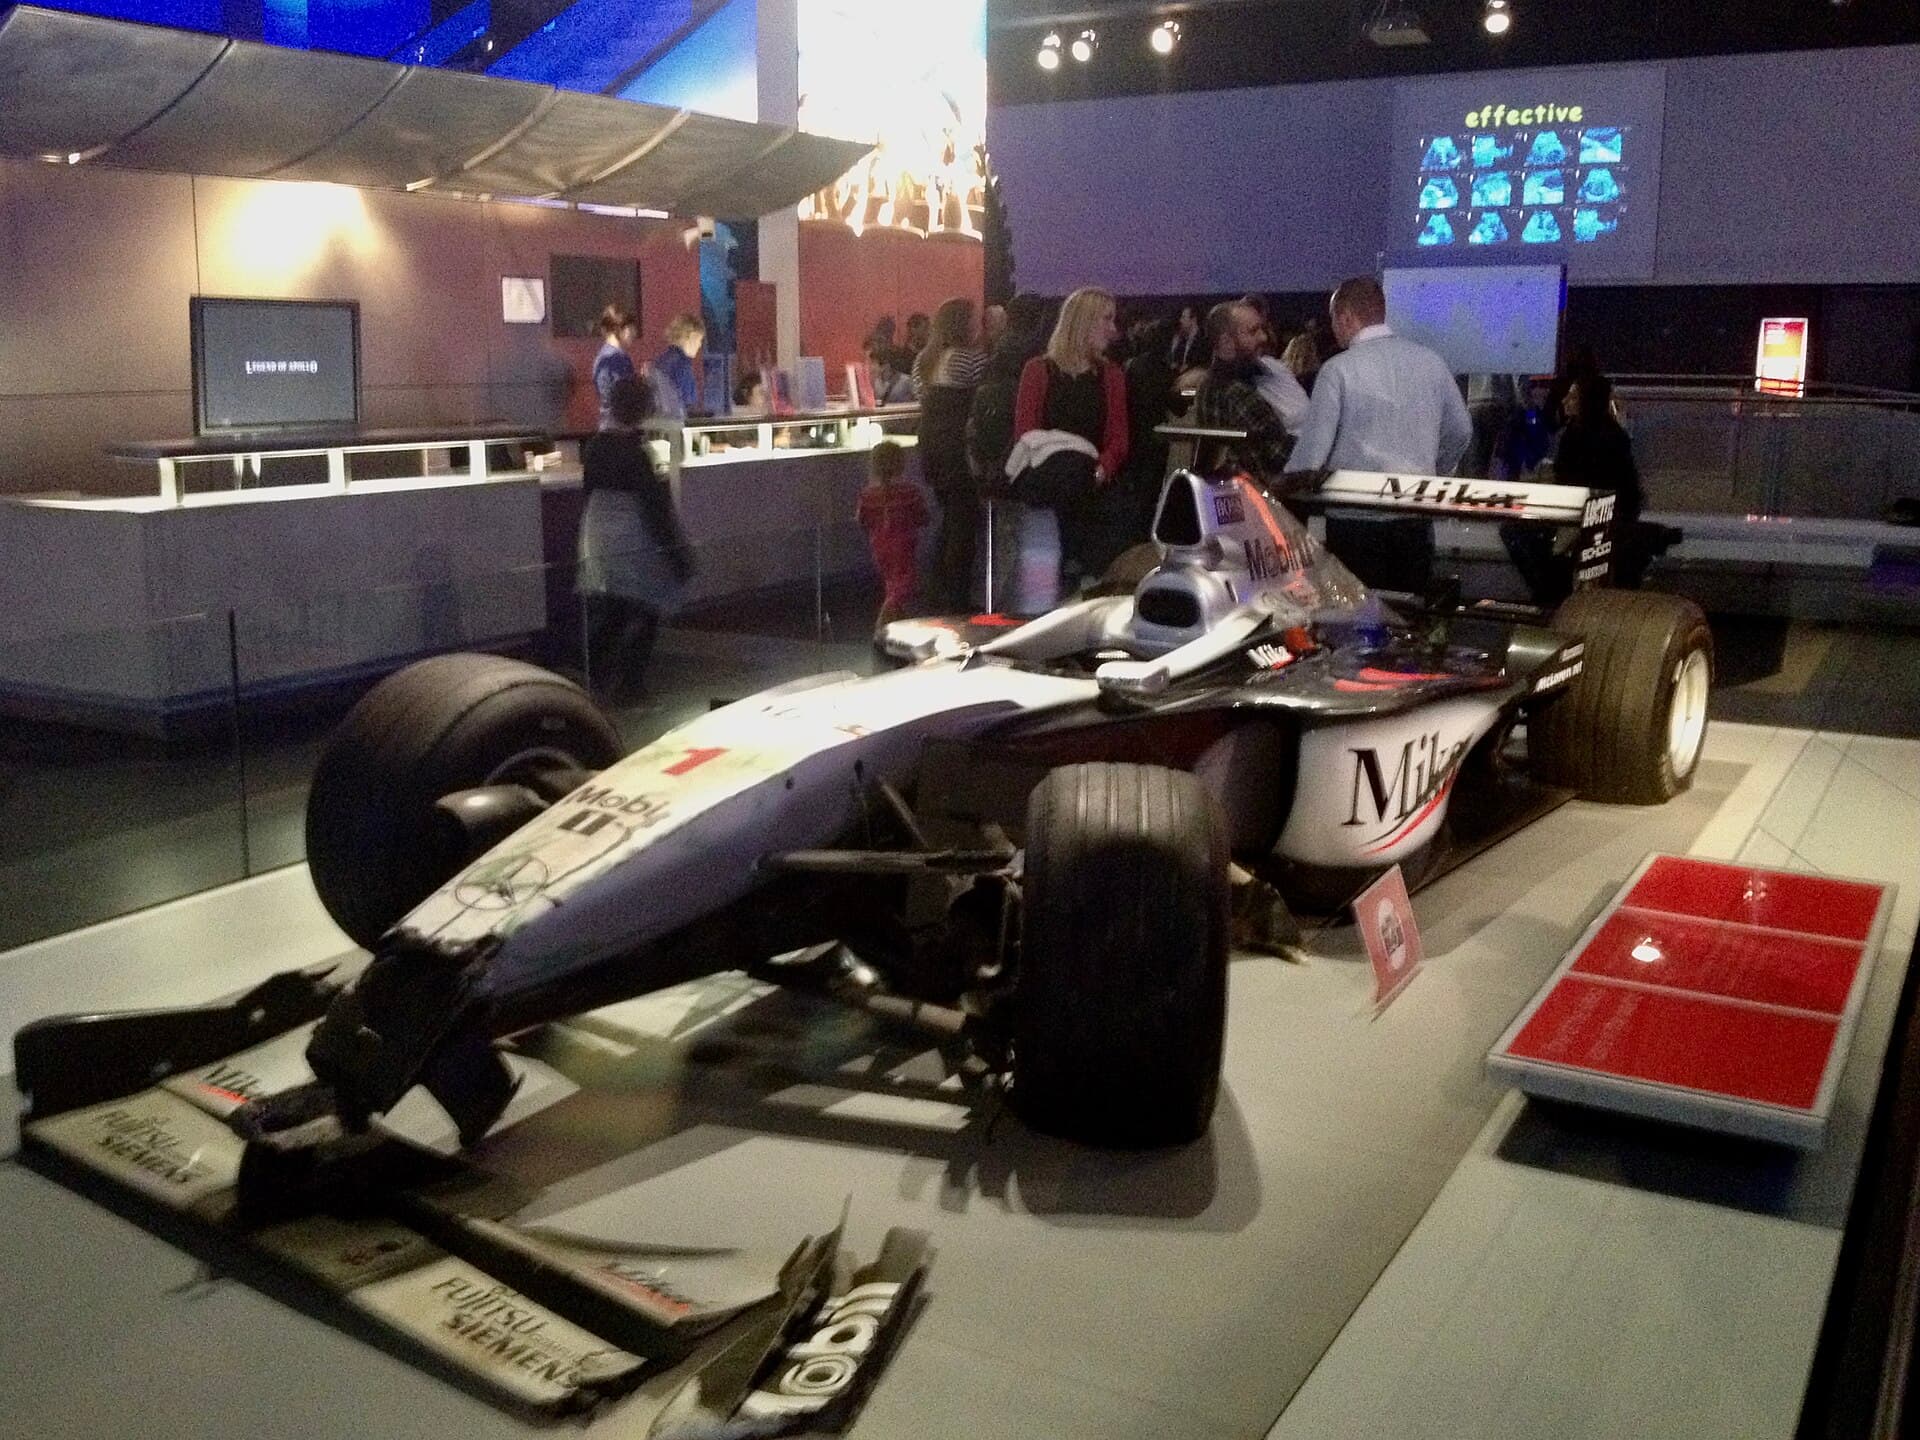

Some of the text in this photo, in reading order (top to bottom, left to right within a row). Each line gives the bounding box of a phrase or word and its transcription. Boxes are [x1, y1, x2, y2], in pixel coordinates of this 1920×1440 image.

[1465, 103, 1583, 128] effective
[1379, 477, 1529, 508] Mika
[662, 747, 731, 776] 1
[1340, 731, 1474, 826] Mika
[431, 1276, 549, 1335] FUJITSU
[443, 1311, 580, 1389] SIEMENS
